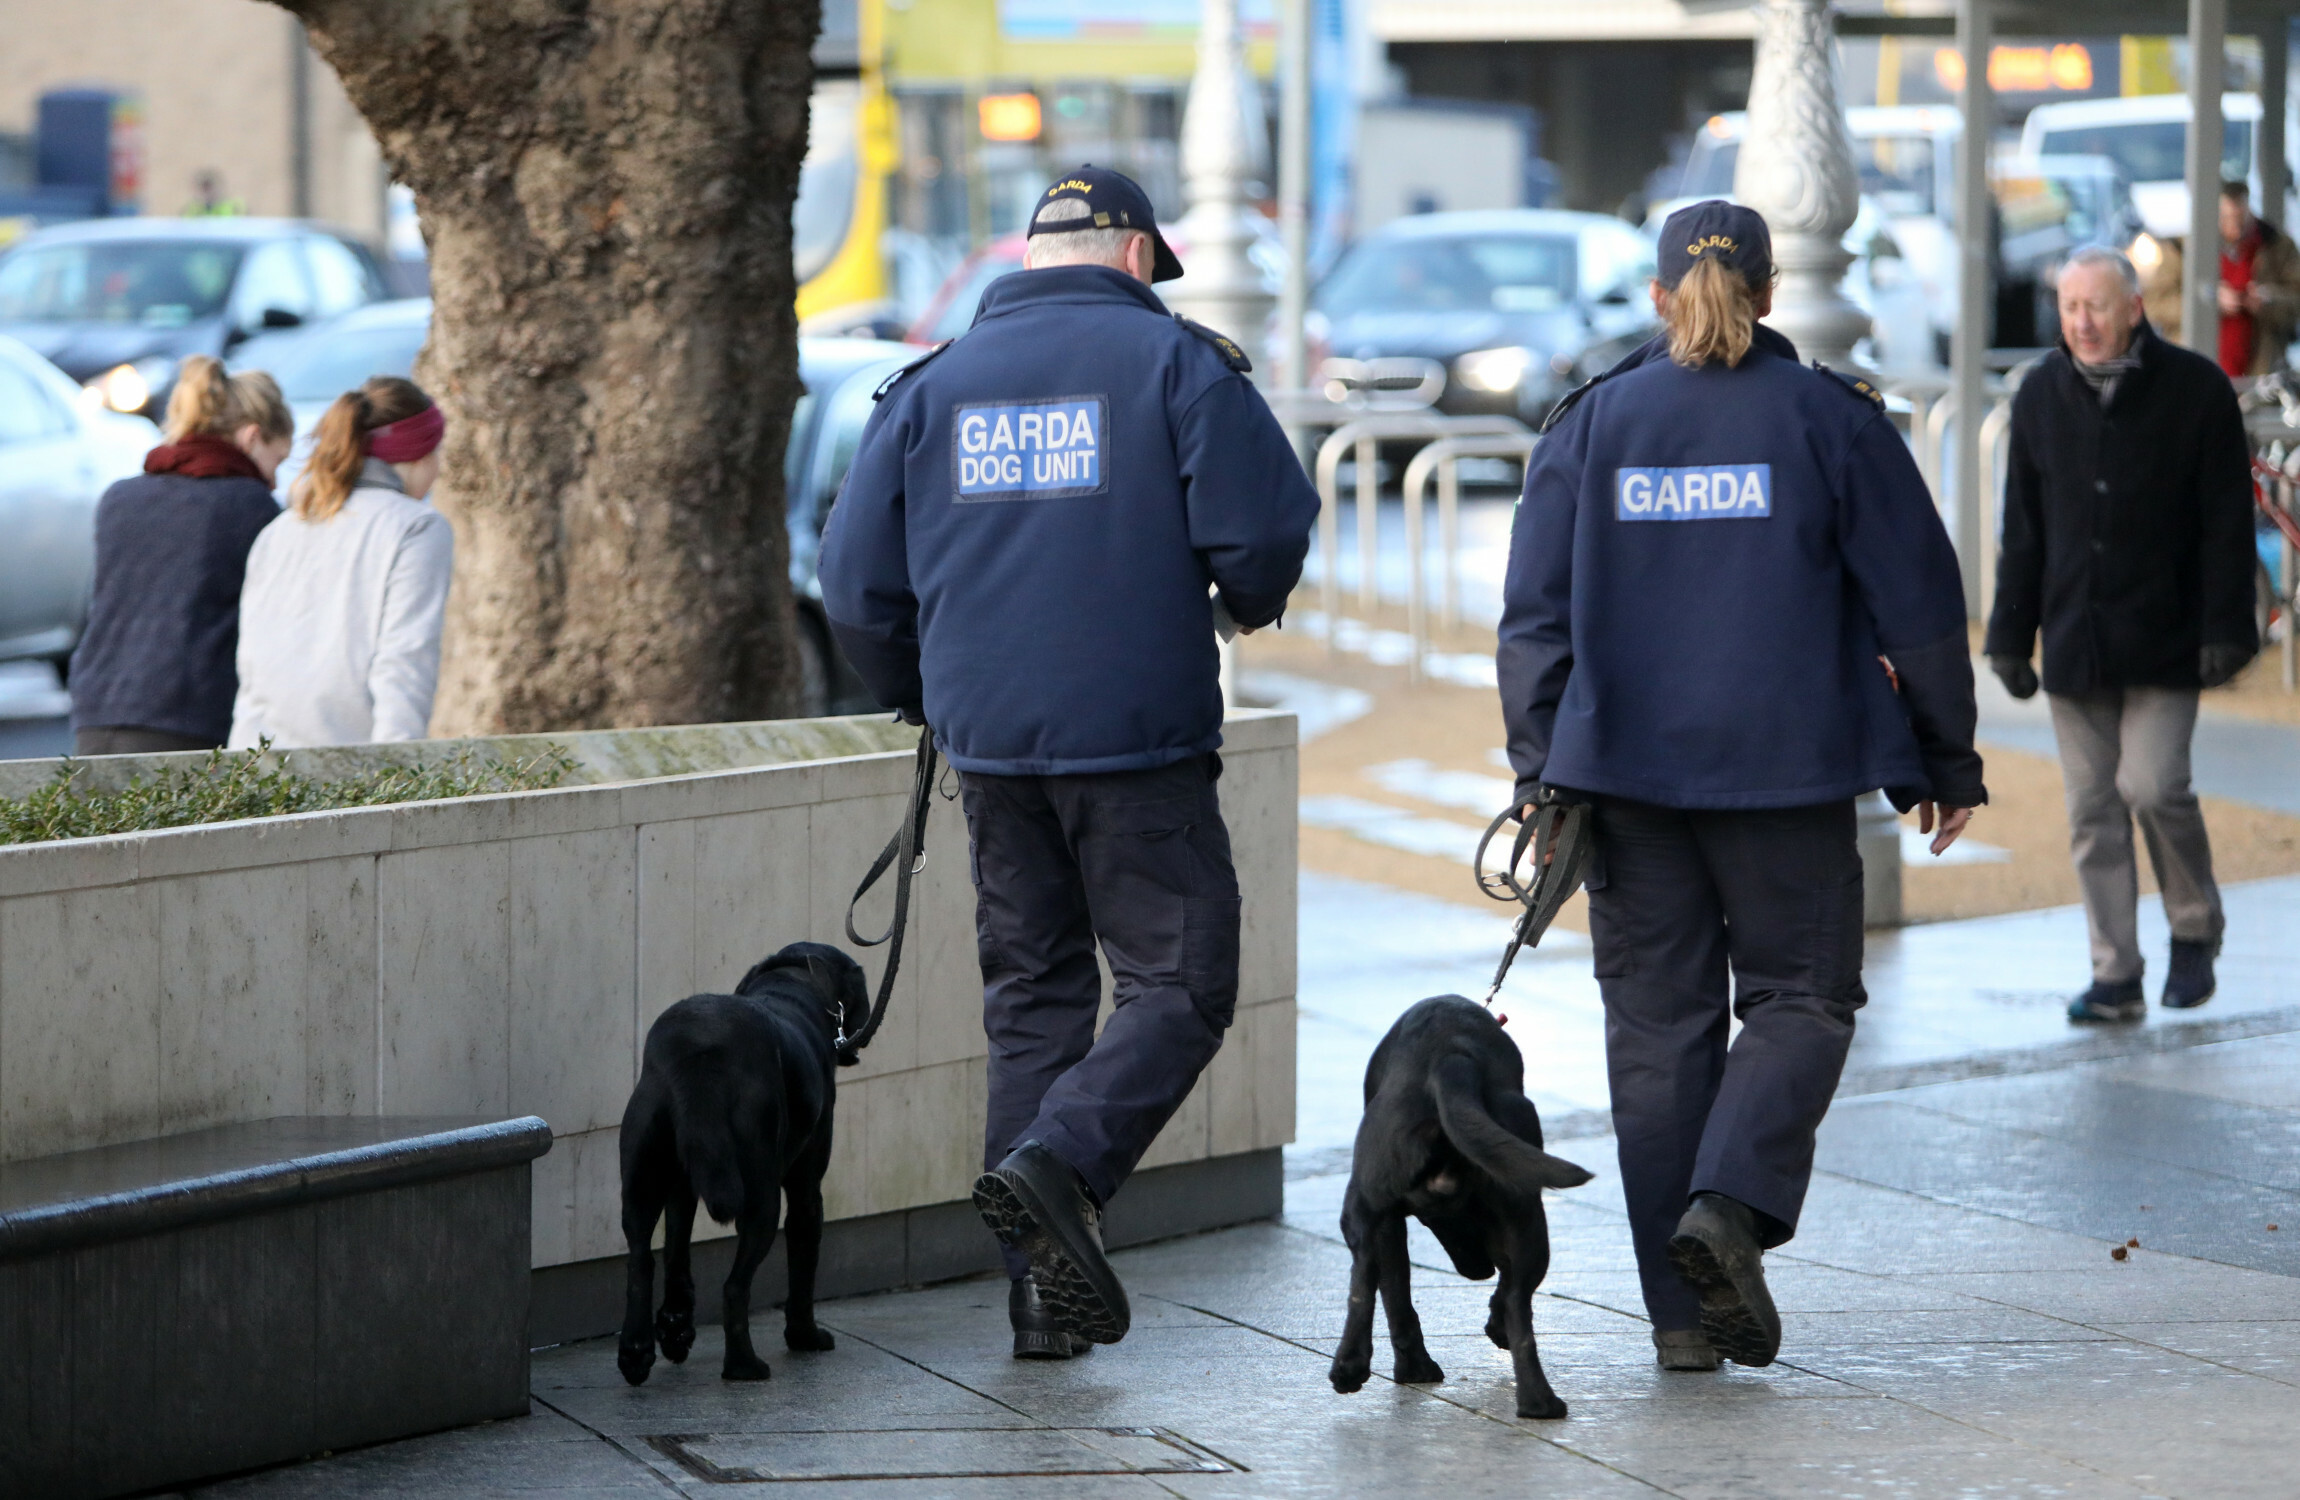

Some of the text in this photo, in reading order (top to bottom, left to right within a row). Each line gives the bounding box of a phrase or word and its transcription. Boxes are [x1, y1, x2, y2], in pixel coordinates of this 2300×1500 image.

[1048, 180, 1093, 197] GARDA
[961, 409, 1096, 453] GARDA
[960, 450, 1096, 486] DOG UNIT
[1622, 471, 1766, 513] GARDA
